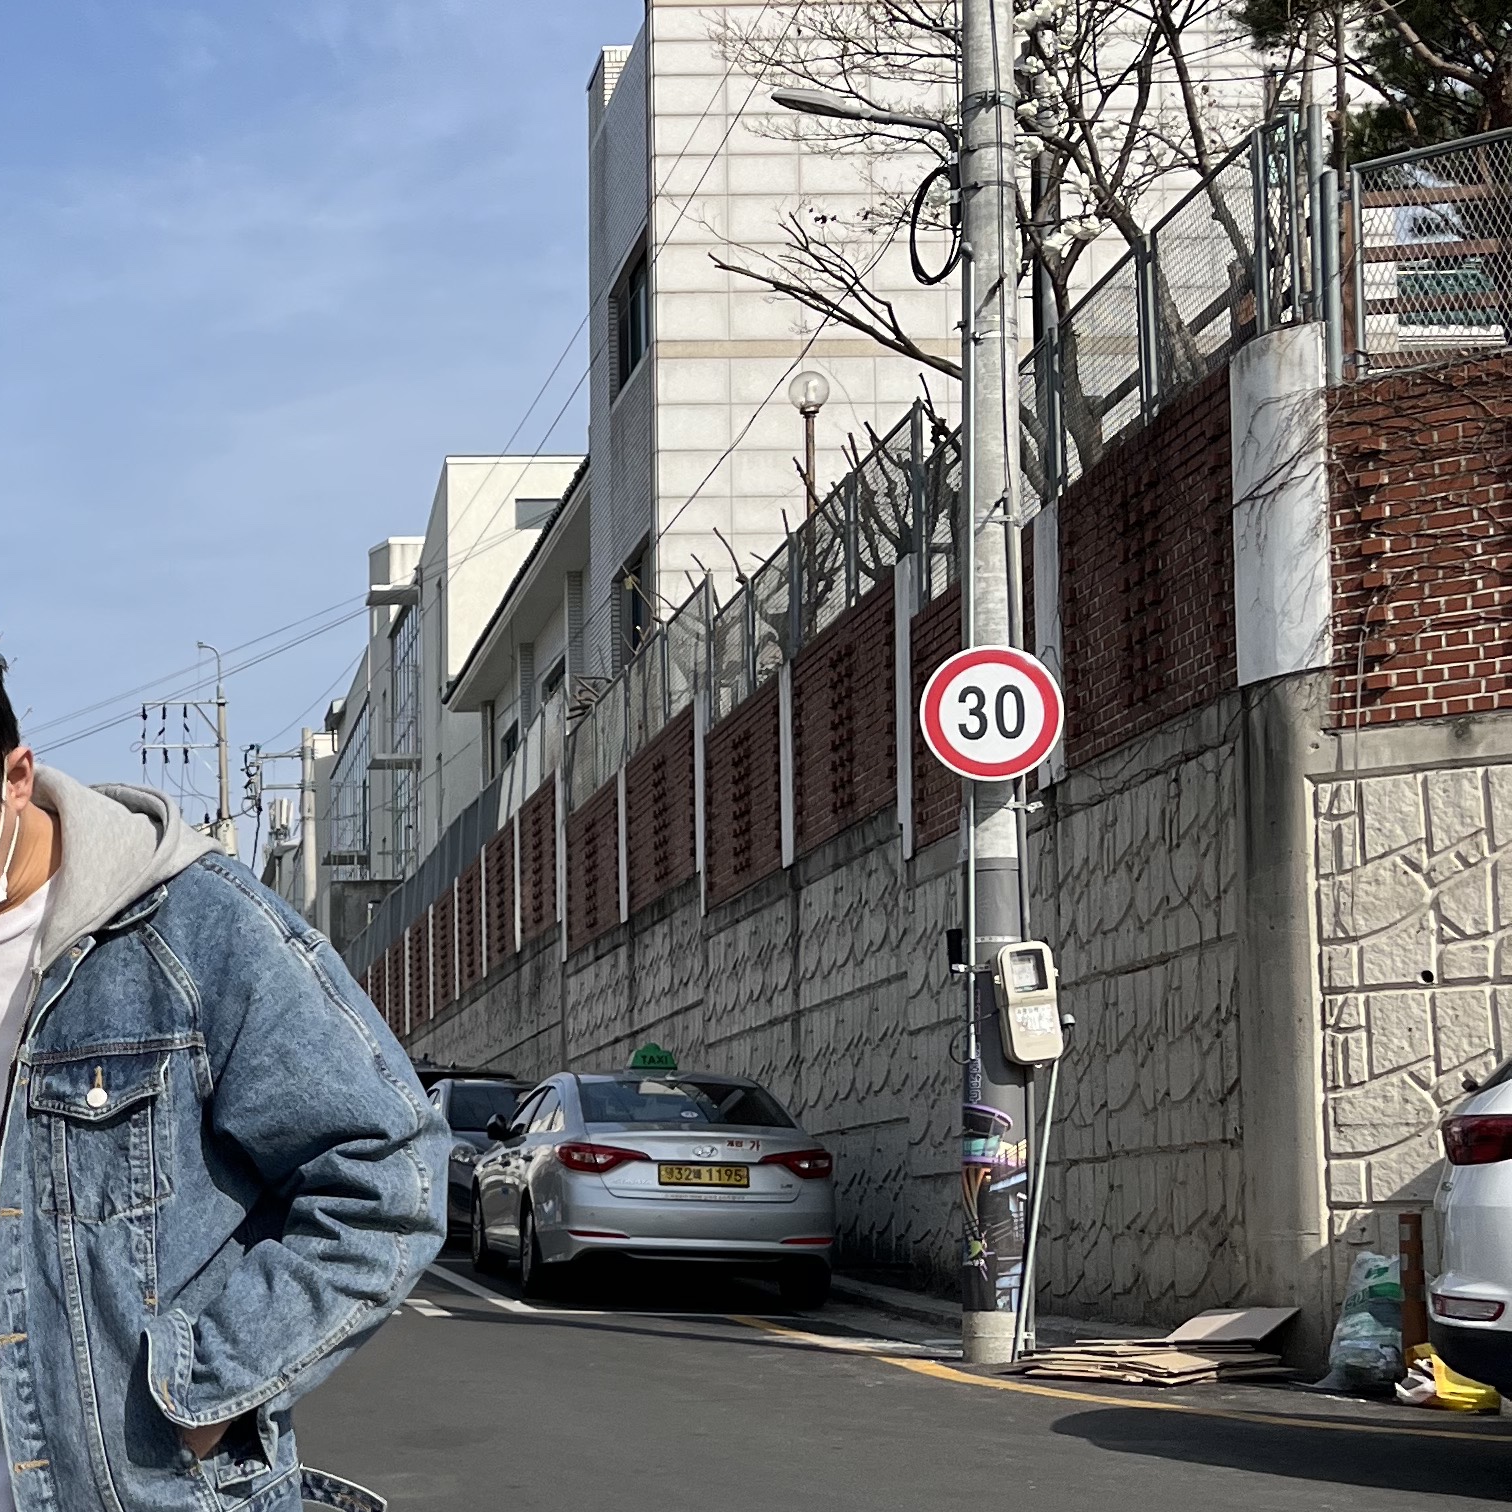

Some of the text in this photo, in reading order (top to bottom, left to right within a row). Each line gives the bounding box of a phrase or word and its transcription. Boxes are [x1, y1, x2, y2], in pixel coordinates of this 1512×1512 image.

[958, 684, 1025, 740] 30
[641, 1055, 668, 1065] TAXI
[706, 1167, 744, 1182] 1195
